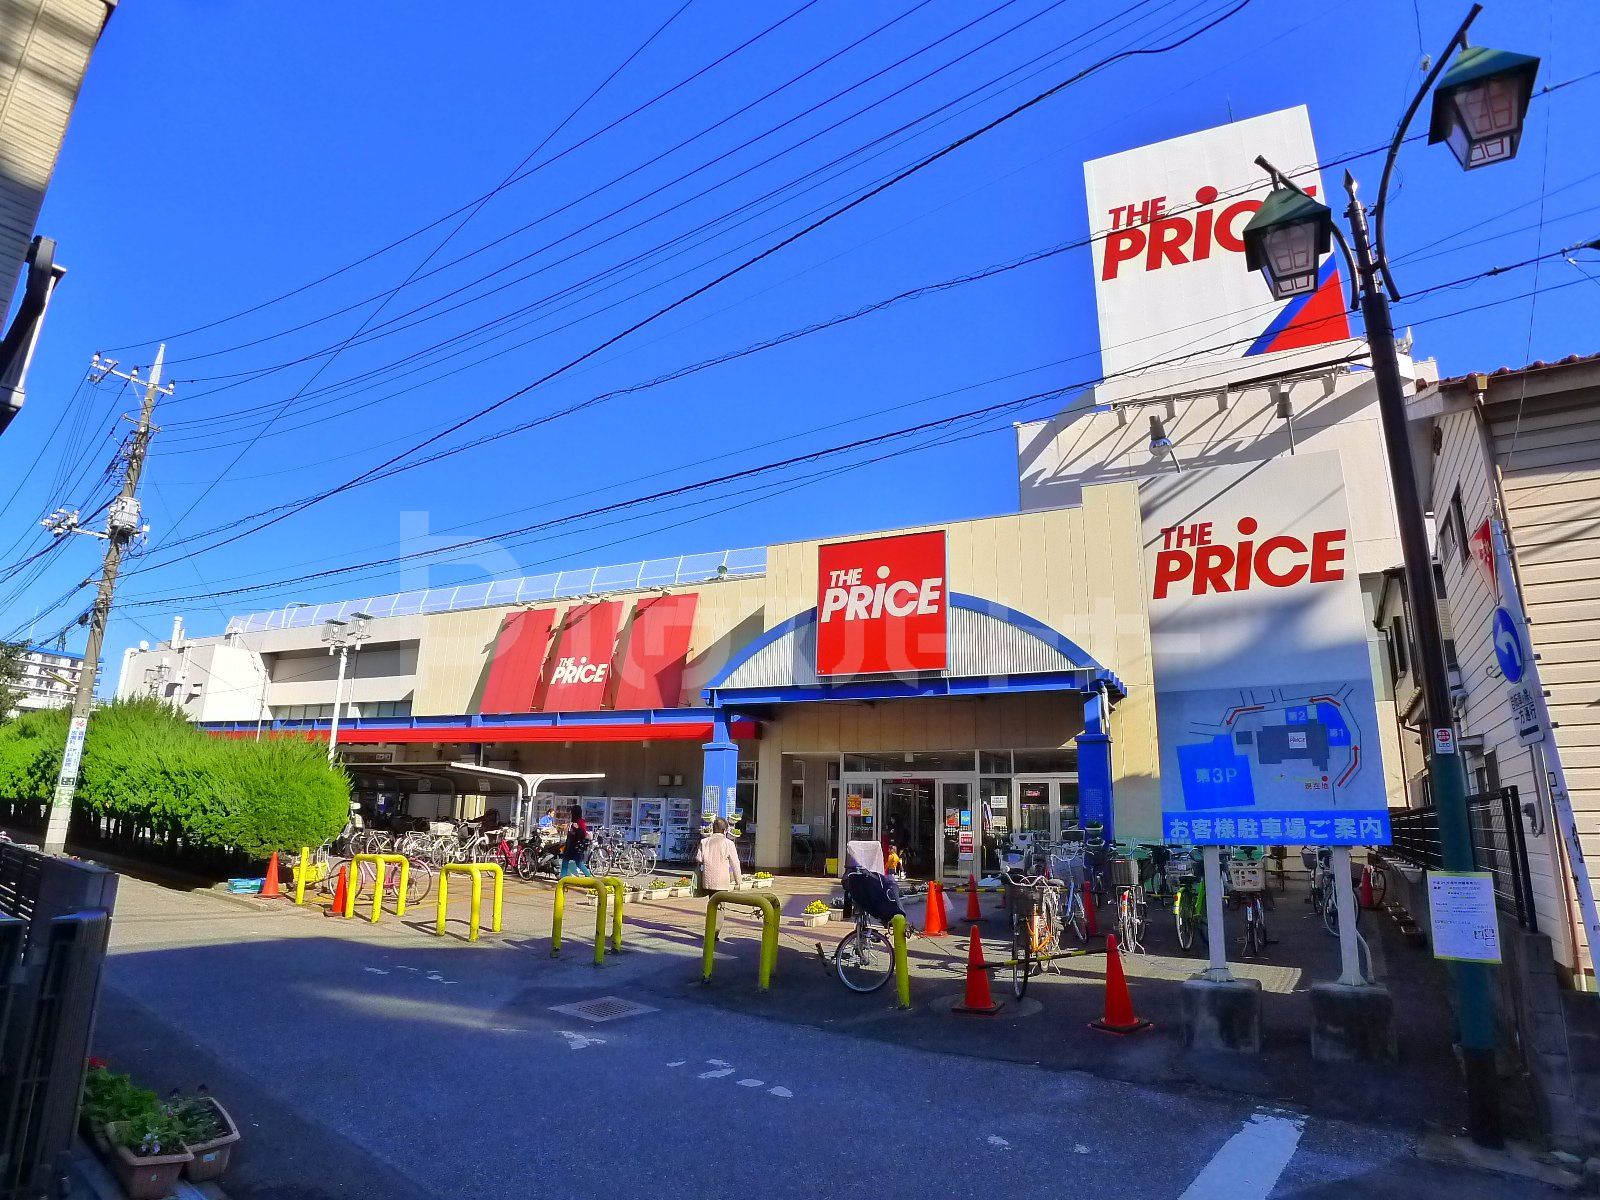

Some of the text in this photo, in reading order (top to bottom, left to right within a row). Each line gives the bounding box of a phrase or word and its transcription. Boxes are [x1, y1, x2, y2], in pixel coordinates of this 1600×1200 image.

[1108, 195, 1167, 231] THE
[1160, 521, 1213, 550] THE
[829, 567, 863, 589] THE
[559, 656, 576, 668] THE
[1169, 815, 1383, 841] お客様駐車場ご案内
